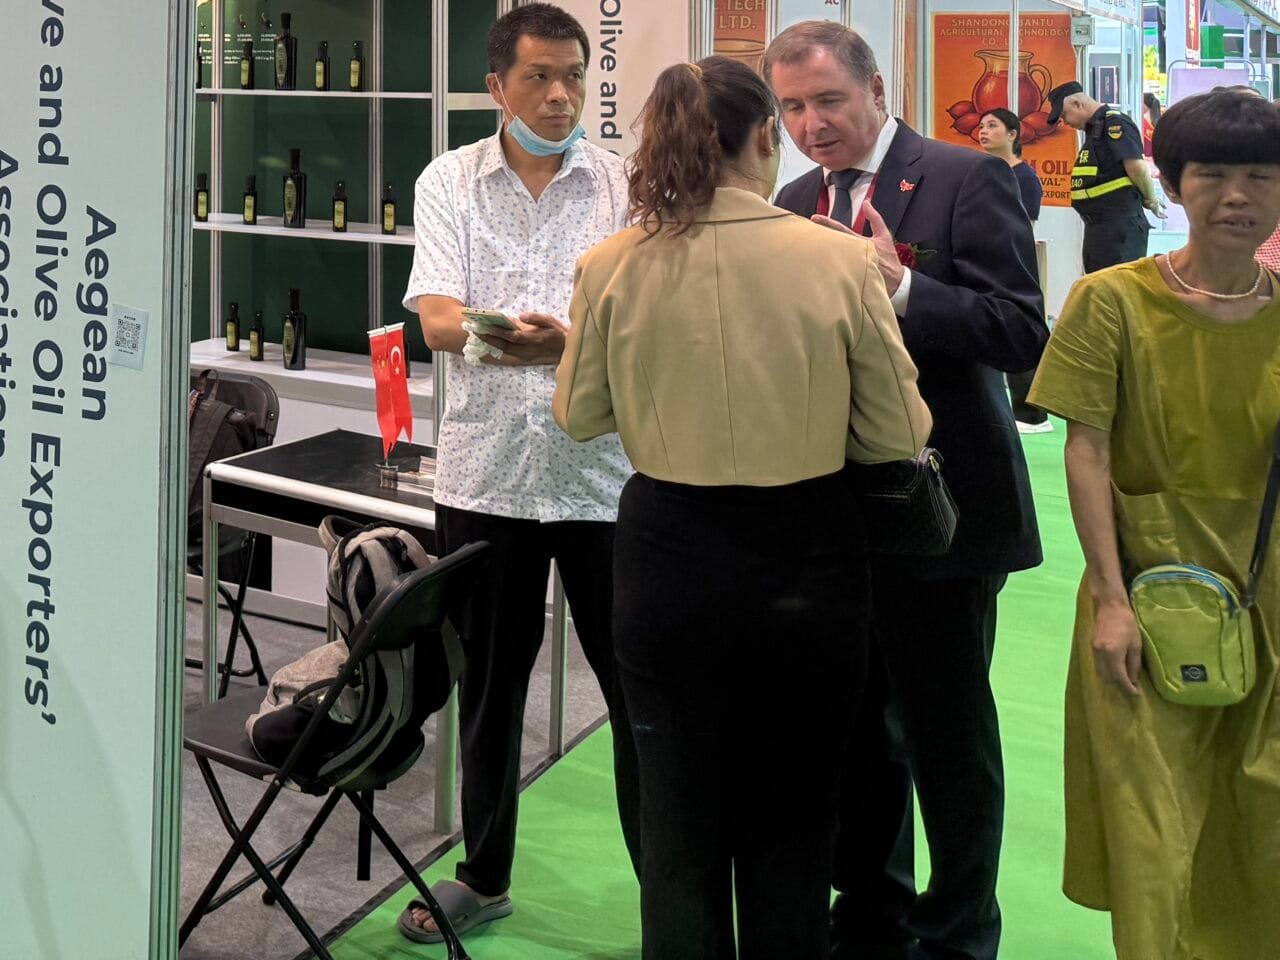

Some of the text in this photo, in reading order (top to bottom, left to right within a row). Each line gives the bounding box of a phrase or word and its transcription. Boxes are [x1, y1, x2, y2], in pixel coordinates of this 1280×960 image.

[719, 15, 756, 29] LTD.
[37, 64, 69, 165] and
[600, 81, 622, 139] and
[1041, 178, 1065, 187] VAL"
[1042, 160, 1071, 176] OIL
[34, 184, 69, 322] Olive
[75, 205, 116, 422] Aegean
[31, 339, 66, 415] Oil
[21, 431, 61, 726] Exporters'
